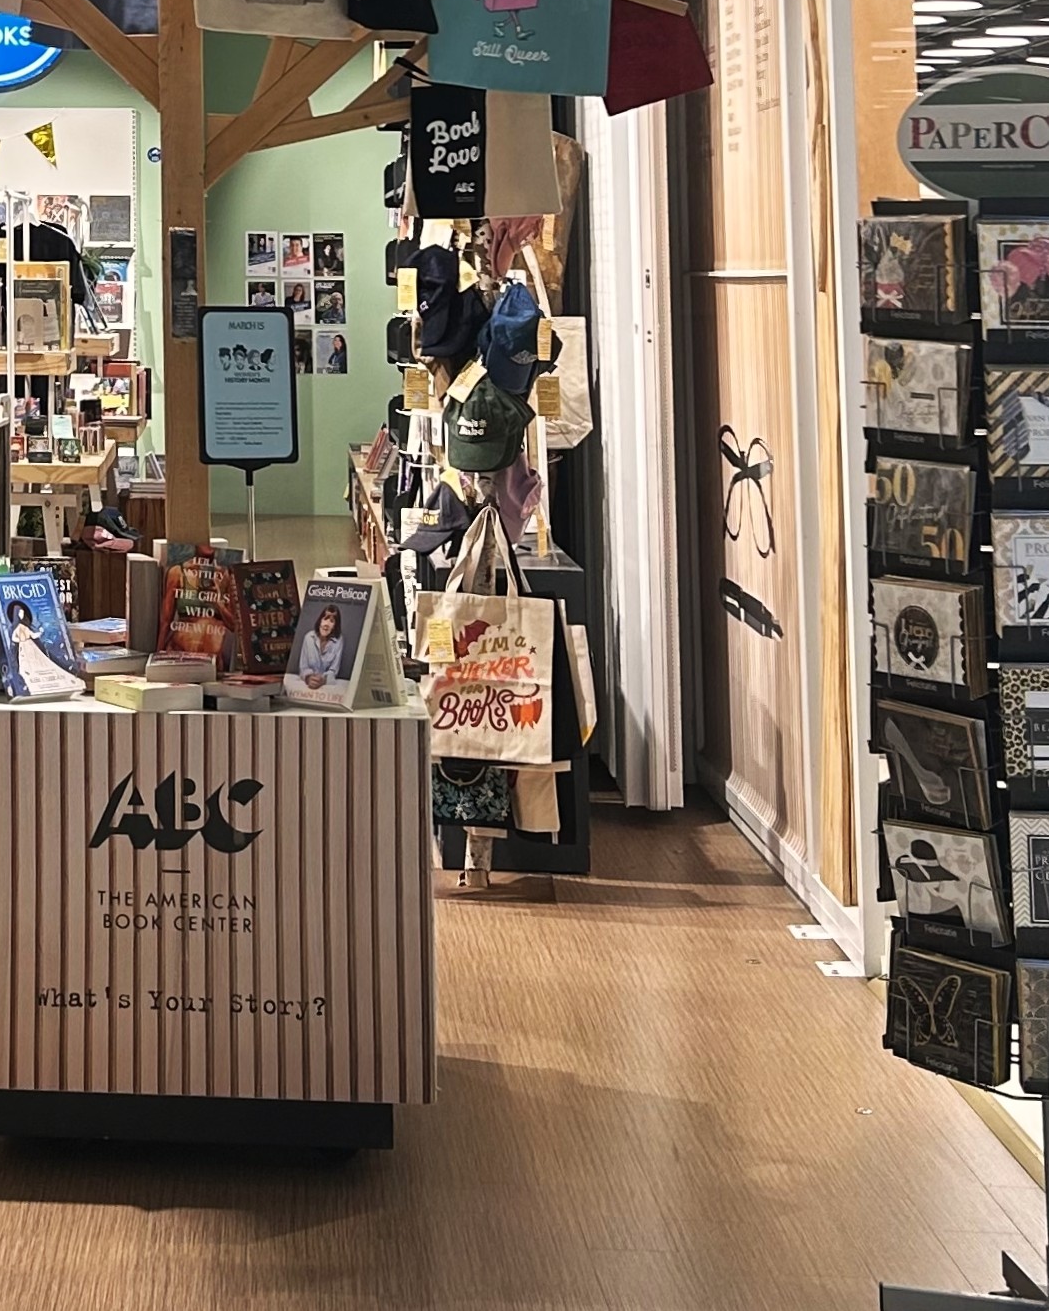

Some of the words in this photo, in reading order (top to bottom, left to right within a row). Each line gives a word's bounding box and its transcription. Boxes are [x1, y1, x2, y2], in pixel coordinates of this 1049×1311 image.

[472, 41, 502, 58] Still
[504, 44, 551, 67] Queer
[454, 182, 476, 193] ABC
[228, 321, 256, 330] MARCH
[257, 321, 265, 330] IS
[1, 582, 47, 600] BRIGID
[174, 588, 197, 600] THE
[198, 590, 231, 603] GIRLS
[307, 584, 335, 599] Gisèle
[335, 586, 368, 601] Pelicot
[185, 605, 215, 618] WHO
[170, 620, 205, 633] GREW
[478, 636, 510, 655] I'M
[514, 635, 527, 648] a
[314, 690, 326, 701] TO
[327, 692, 344, 703] LIFE
[432, 685, 516, 732] BOOKS
[88, 770, 264, 854] ABC
[97, 890, 135, 907] THE
[145, 892, 257, 911] AMERICAN
[103, 913, 163, 930] BOOK
[173, 915, 253, 934] CENTER
[37, 986, 131, 1009] What's
[148, 990, 213, 1012] Your
[229, 993, 327, 1021] Story?
